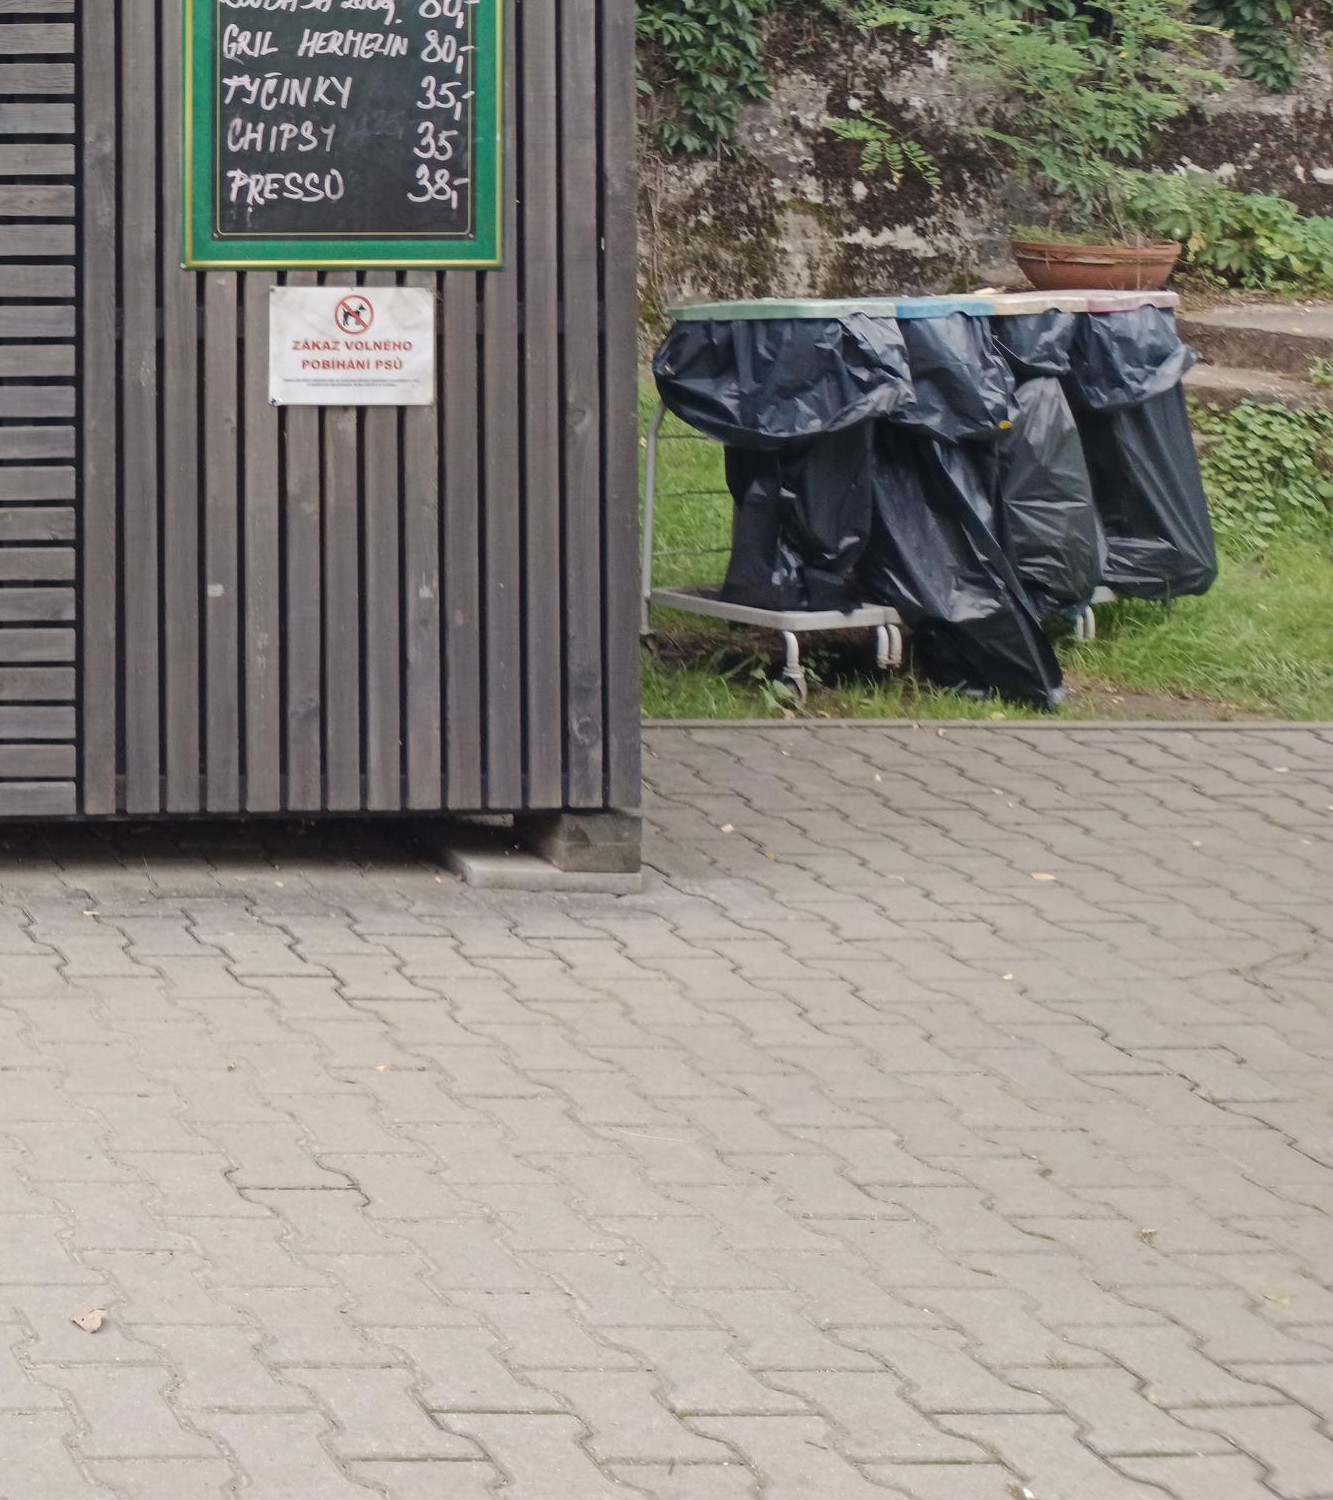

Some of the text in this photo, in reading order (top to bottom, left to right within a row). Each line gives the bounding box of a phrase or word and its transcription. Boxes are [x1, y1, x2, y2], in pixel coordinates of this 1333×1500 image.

[222, 23, 279, 58] GRIL
[222, 71, 353, 111] TYČINKY
[227, 117, 459, 161] CHIPSY 35
[226, 168, 345, 206] PRESSO
[292, 338, 413, 351] ZÁKAZ VOLNÉHO
[302, 358, 370, 370] POBÍHÁNÍ
